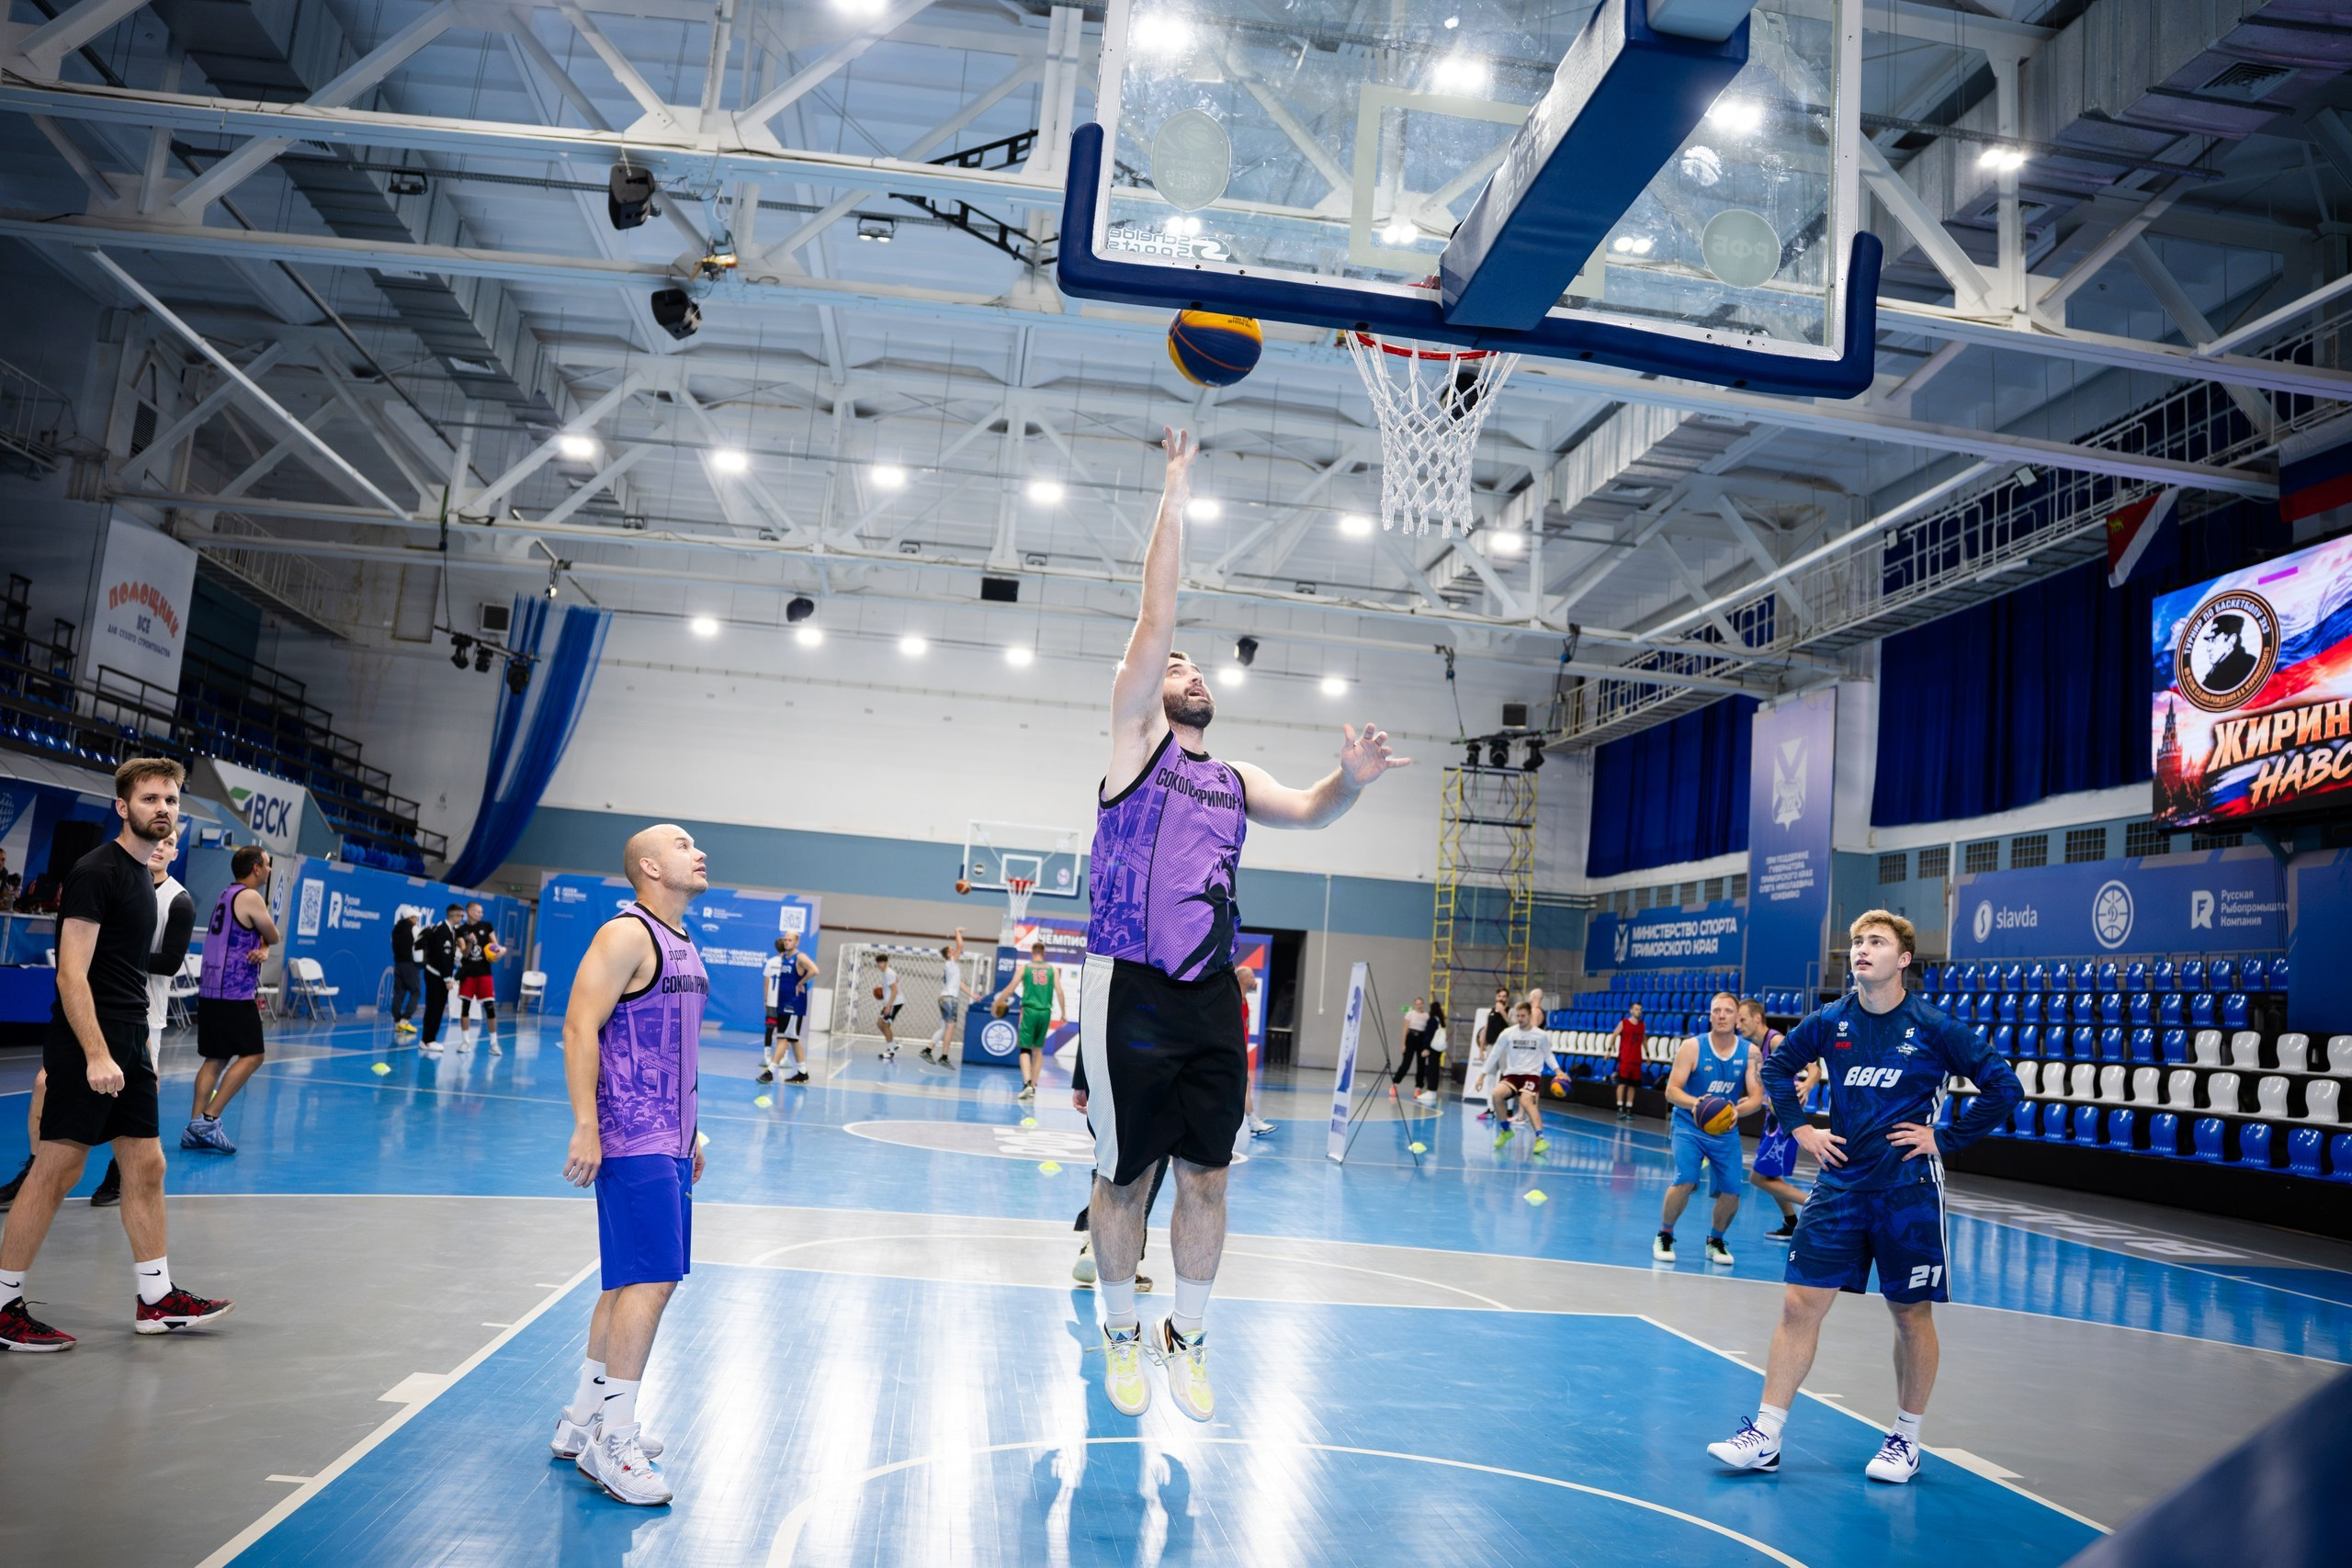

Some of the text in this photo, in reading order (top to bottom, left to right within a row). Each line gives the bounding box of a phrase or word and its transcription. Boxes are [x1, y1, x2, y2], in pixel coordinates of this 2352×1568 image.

[108, 581, 179, 638] ПОМОЩНИК
[136, 615, 151, 634] ВСЕ
[2184, 620, 2203, 654] ТУРНИР
[2202, 608, 2215, 622] ПО
[2215, 599, 2263, 618] БАСКЕТБОЛУ
[2206, 698, 2352, 773] ЖИРИН
[252, 793, 292, 838] ВСК
[2222, 889, 2254, 901] Русская
[1996, 904, 2038, 929] slavda
[2221, 916, 2261, 927] Компания
[1632, 917, 1737, 941] МИНИСТЕРСТВО СПОРТА
[1631, 938, 1719, 958] ПРИМОРСКОГО КРАЯ
[1032, 969, 1047, 985] 15
[1908, 1265, 1942, 1289] 21
